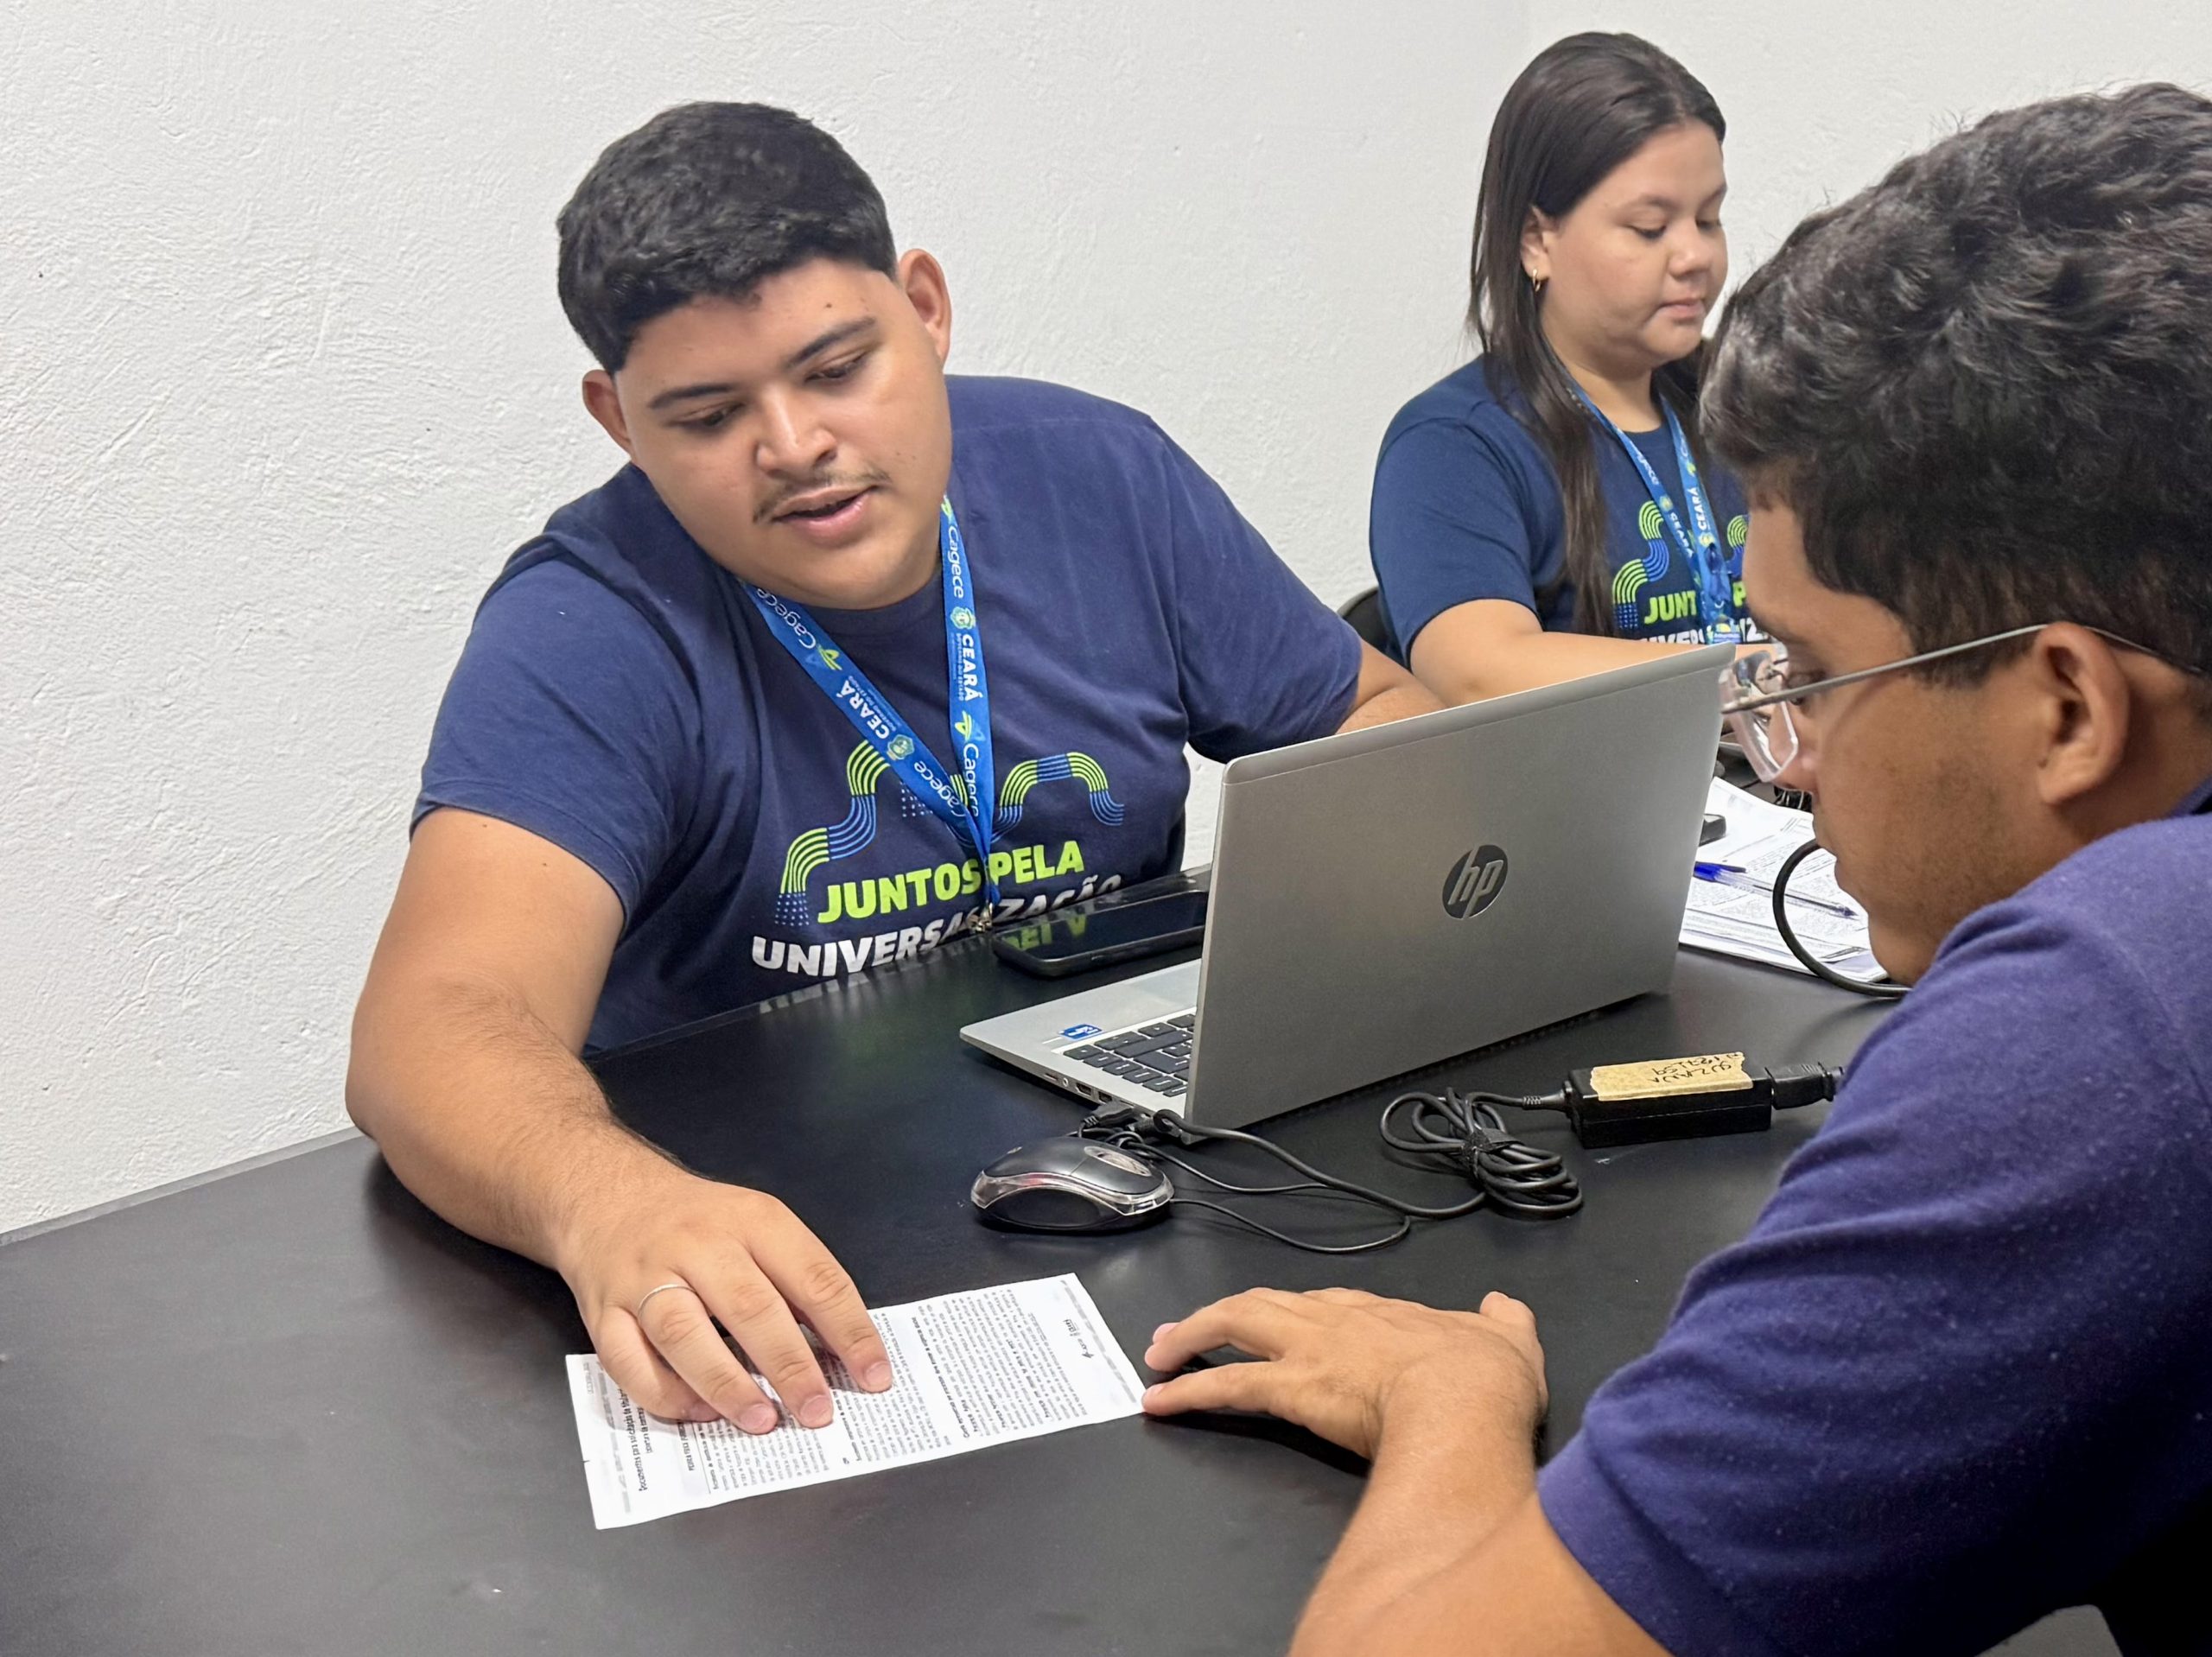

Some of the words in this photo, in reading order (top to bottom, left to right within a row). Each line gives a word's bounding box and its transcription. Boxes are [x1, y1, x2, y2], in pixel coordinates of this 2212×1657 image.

[948, 525, 964, 598] Cagece
[757, 587, 817, 649] Cagece
[1643, 590, 1697, 625] JUNT
[963, 633, 982, 701] CEARÁ
[836, 680, 890, 740] CEARÁ
[817, 859, 982, 924] JUNTOS
[988, 840, 1084, 885] PELA
[1446, 845, 1505, 918] hp
